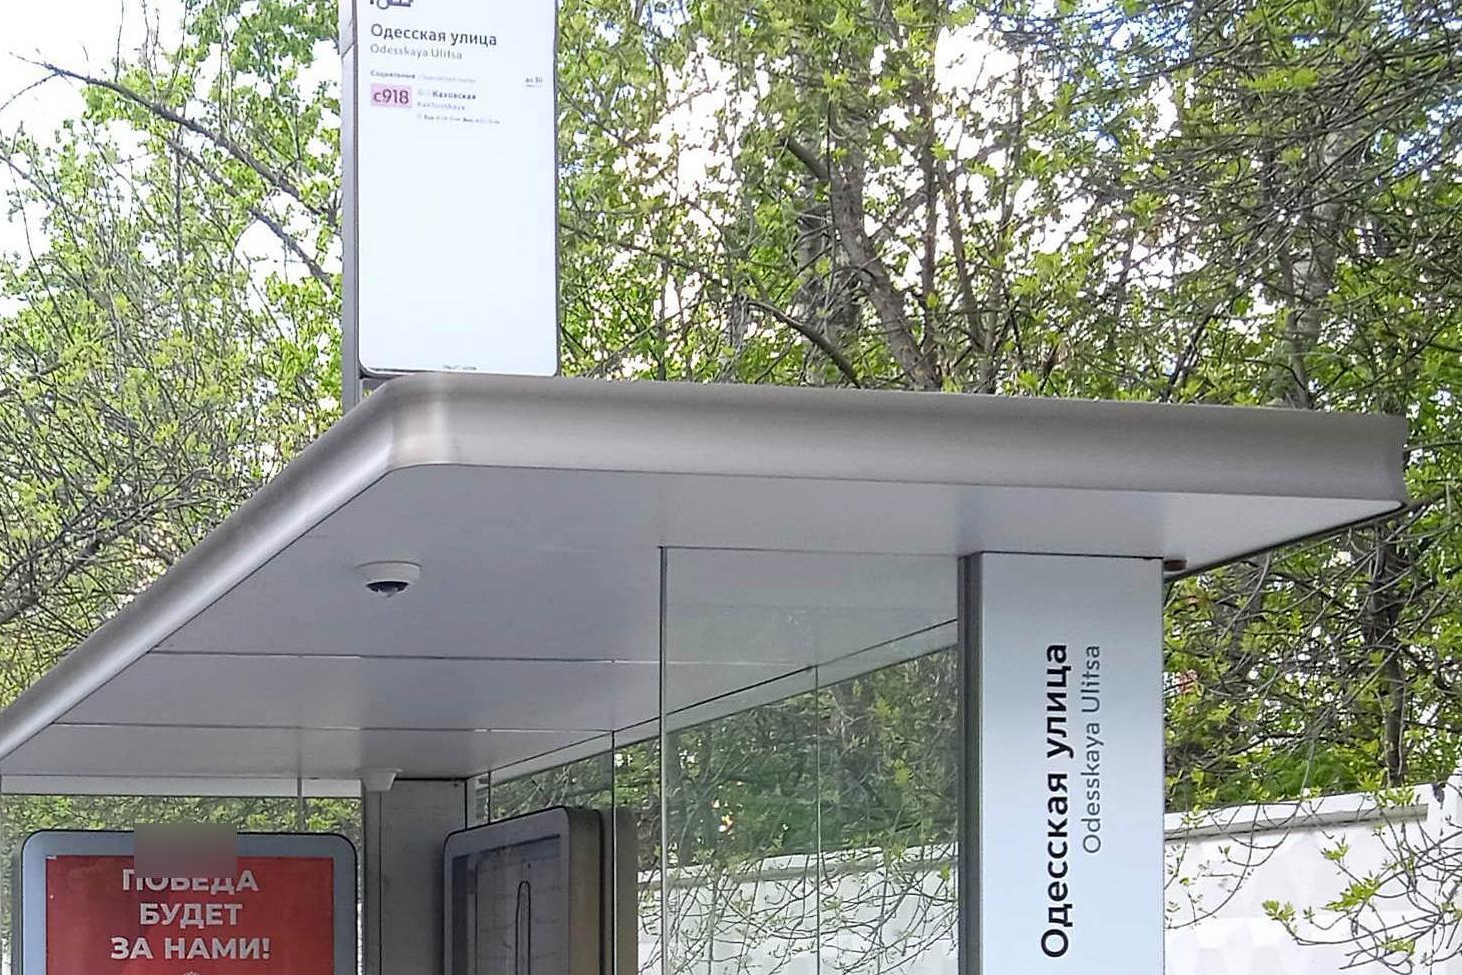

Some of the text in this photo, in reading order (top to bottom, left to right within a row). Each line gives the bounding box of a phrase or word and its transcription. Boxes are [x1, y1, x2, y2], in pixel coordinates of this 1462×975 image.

[370, 23, 498, 47] Одесская улица
[370, 43, 463, 60] Odesskaya Ulitsa
[1080, 644, 1105, 854] Odesskaya Ulitsa
[1040, 643, 1075, 958] Одесская улица
[139, 903, 242, 929] БУДЕТ
[110, 937, 271, 960] ЗА НАМИ!
